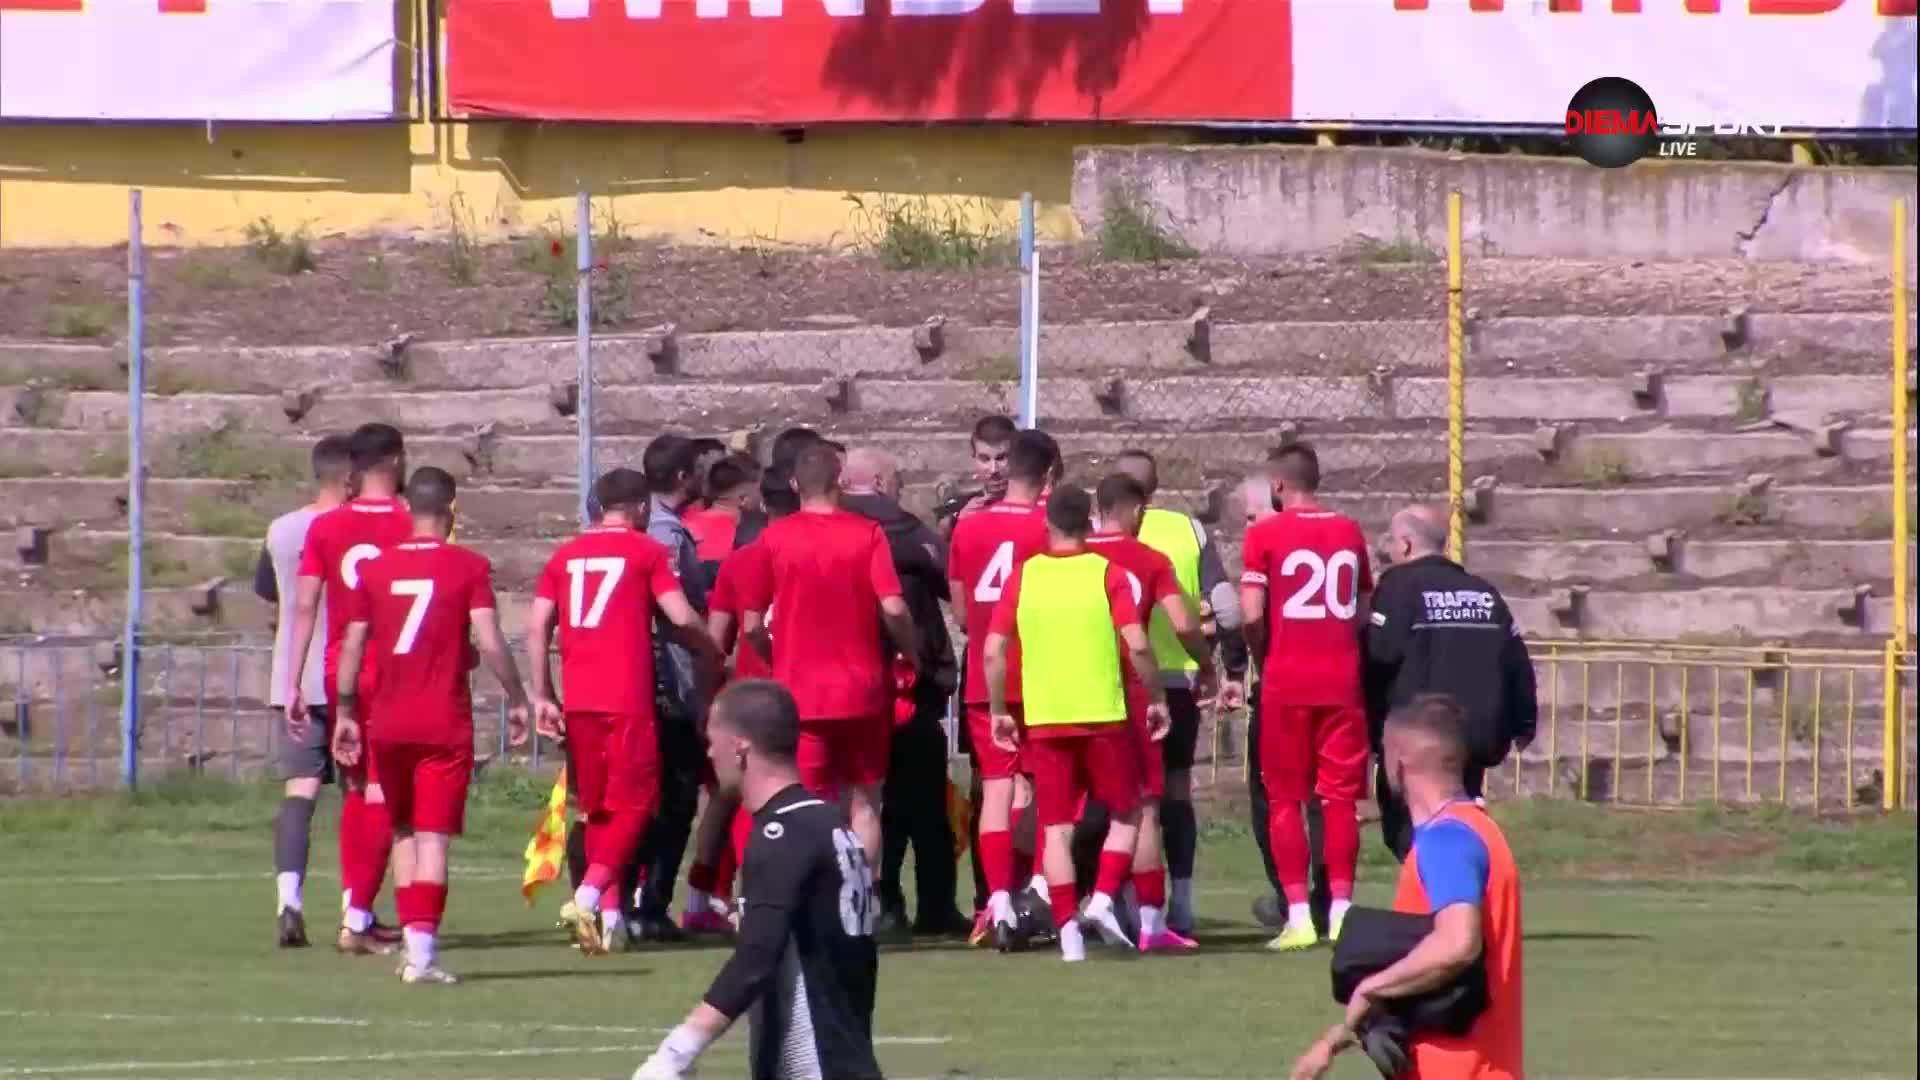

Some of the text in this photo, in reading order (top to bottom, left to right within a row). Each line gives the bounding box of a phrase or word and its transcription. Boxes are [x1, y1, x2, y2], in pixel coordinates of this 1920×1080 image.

[391, 579, 434, 654] 7
[566, 556, 625, 629] 17
[1281, 549, 1358, 620] 20
[1422, 590, 1495, 608] TRAFFIC
[1426, 609, 1492, 621] SECURITY
